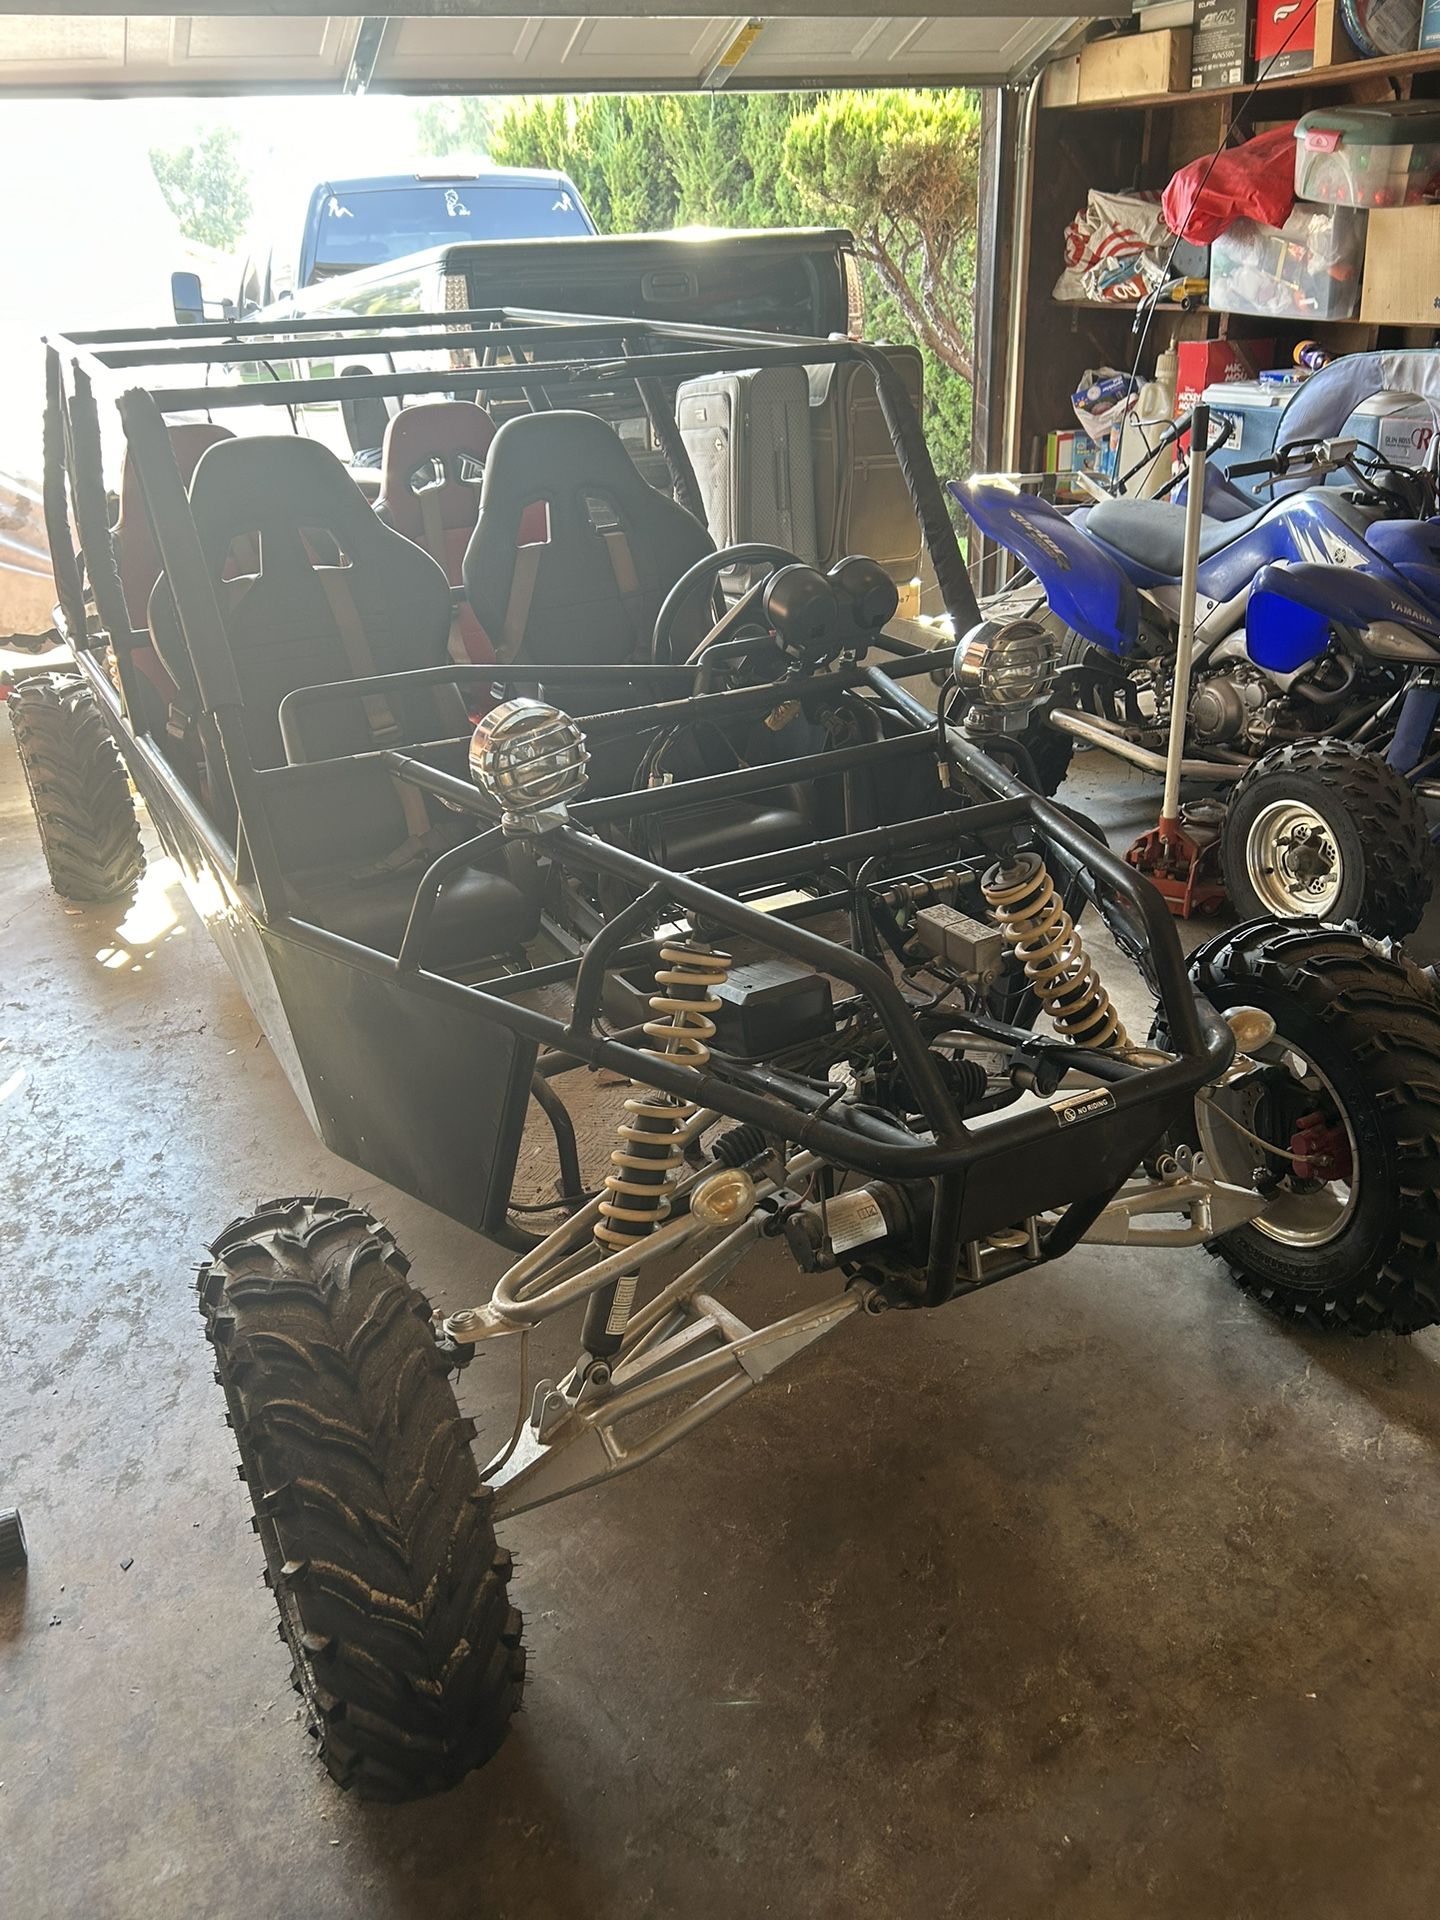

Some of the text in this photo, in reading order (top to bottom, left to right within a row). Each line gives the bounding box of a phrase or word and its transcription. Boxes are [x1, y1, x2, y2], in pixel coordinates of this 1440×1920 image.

[1390, 600, 1433, 625] YAMAHA
[1077, 1106, 1087, 1114] NO
[1087, 1098, 1108, 1111] RIDING
